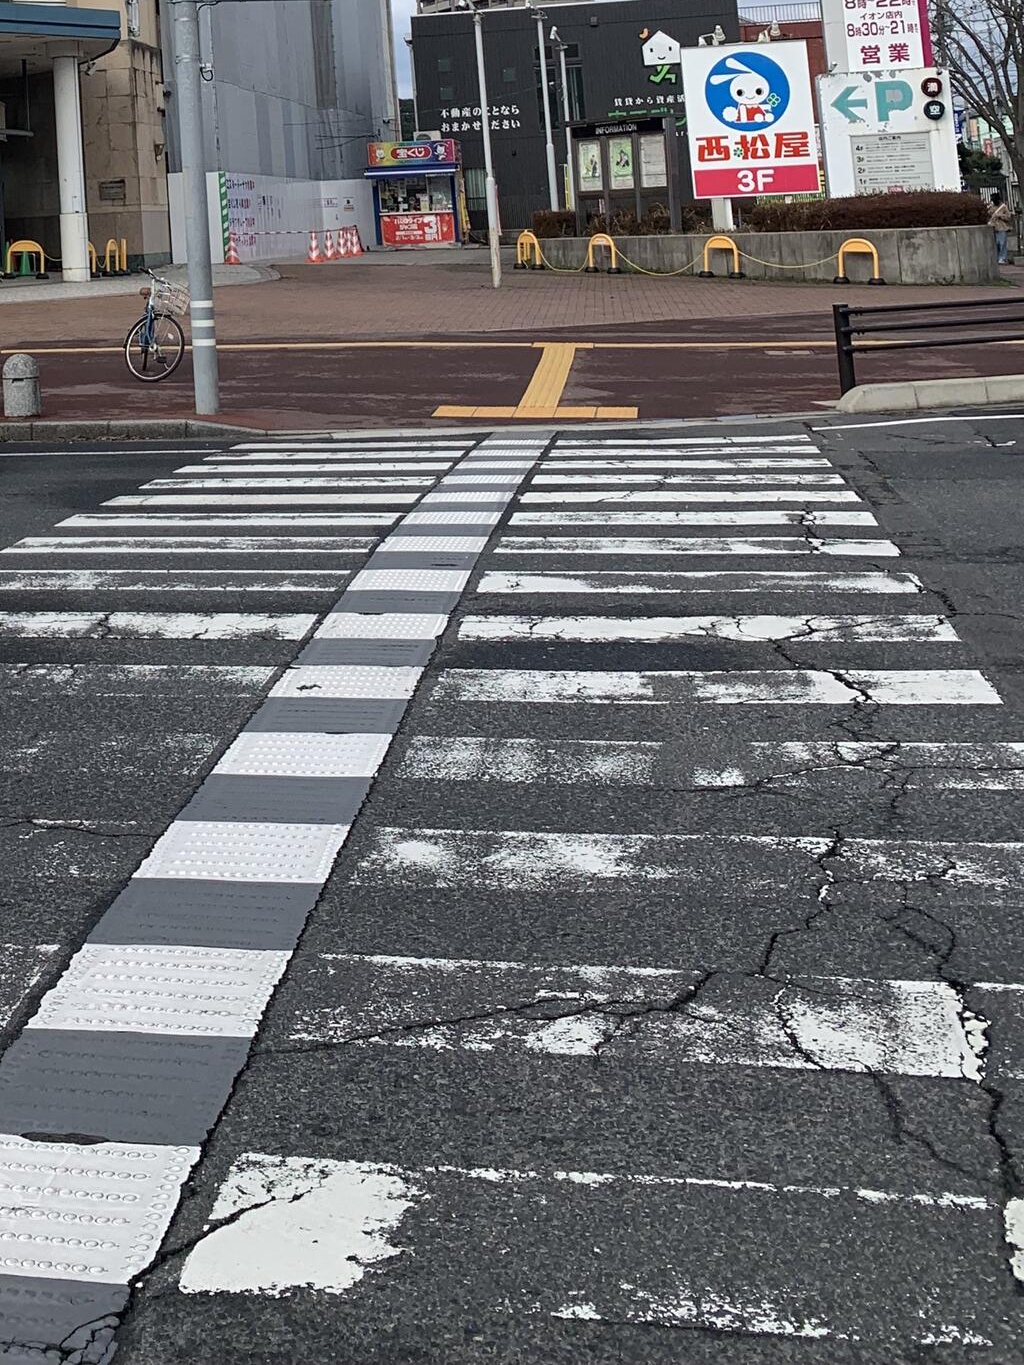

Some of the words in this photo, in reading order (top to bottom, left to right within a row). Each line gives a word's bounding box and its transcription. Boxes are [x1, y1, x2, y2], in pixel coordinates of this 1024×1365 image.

[860, 10, 903, 21] イオン店内
[860, 43, 910, 65] 営業
[874, 80, 914, 123] P
[929, 105, 941, 115] 空
[440, 120, 521, 132] おまかせださい
[595, 124, 638, 135] INFORMATION
[696, 132, 811, 162] 西松屋
[737, 169, 775, 192] 3F
[423, 215, 437, 234] 3
